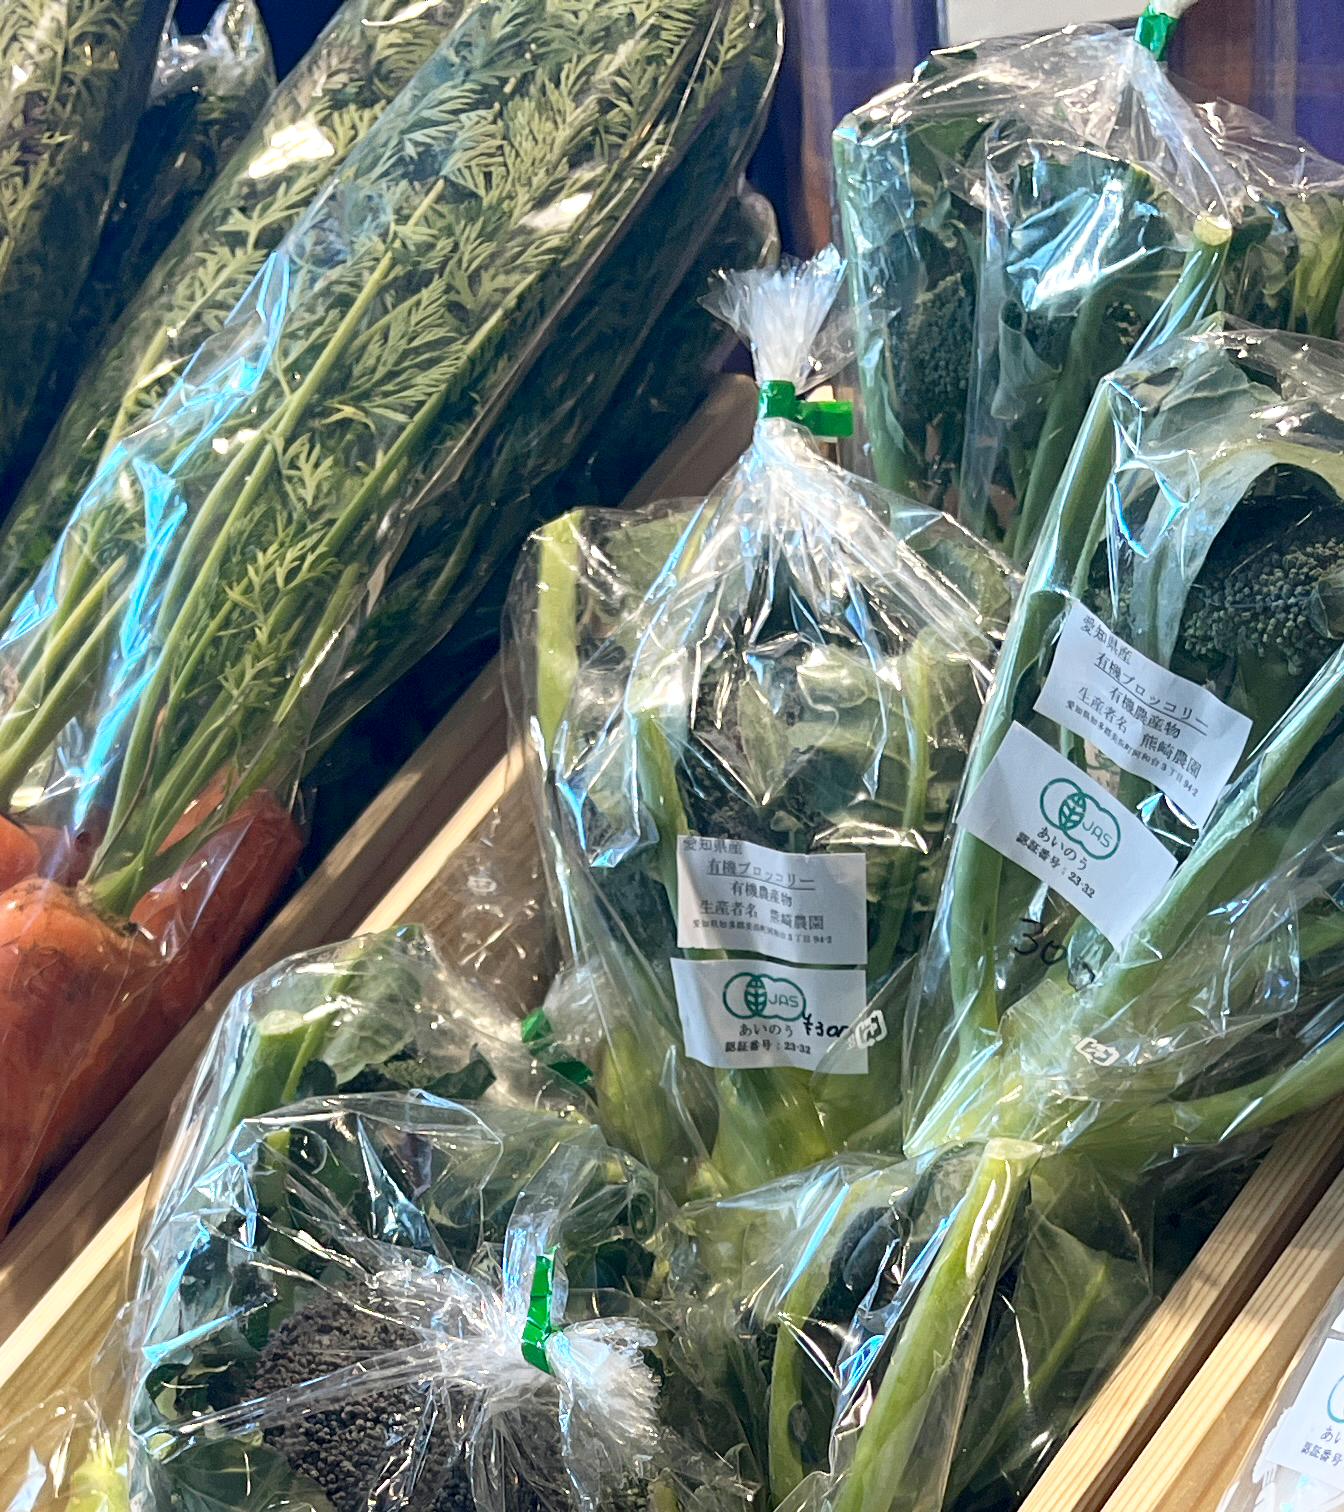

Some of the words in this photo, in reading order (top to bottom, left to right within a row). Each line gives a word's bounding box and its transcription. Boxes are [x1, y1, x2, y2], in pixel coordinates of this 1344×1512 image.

[1079, 614, 1133, 666] 愛知県産
[1095, 652, 1209, 730] 有機ブロッコリー
[1078, 686, 1128, 734] 生産者名
[1108, 686, 1182, 740] 有機農産物
[682, 835, 744, 855] 愛知県産
[1036, 825, 1089, 871] あいのう
[1081, 820, 1113, 849] JAS
[707, 857, 816, 889] 有機ブロッコリー
[730, 879, 794, 908] 有機農産物
[699, 899, 759, 919] 生産者名
[767, 993, 800, 1009] JAS
[738, 1023, 795, 1038] あいのう
